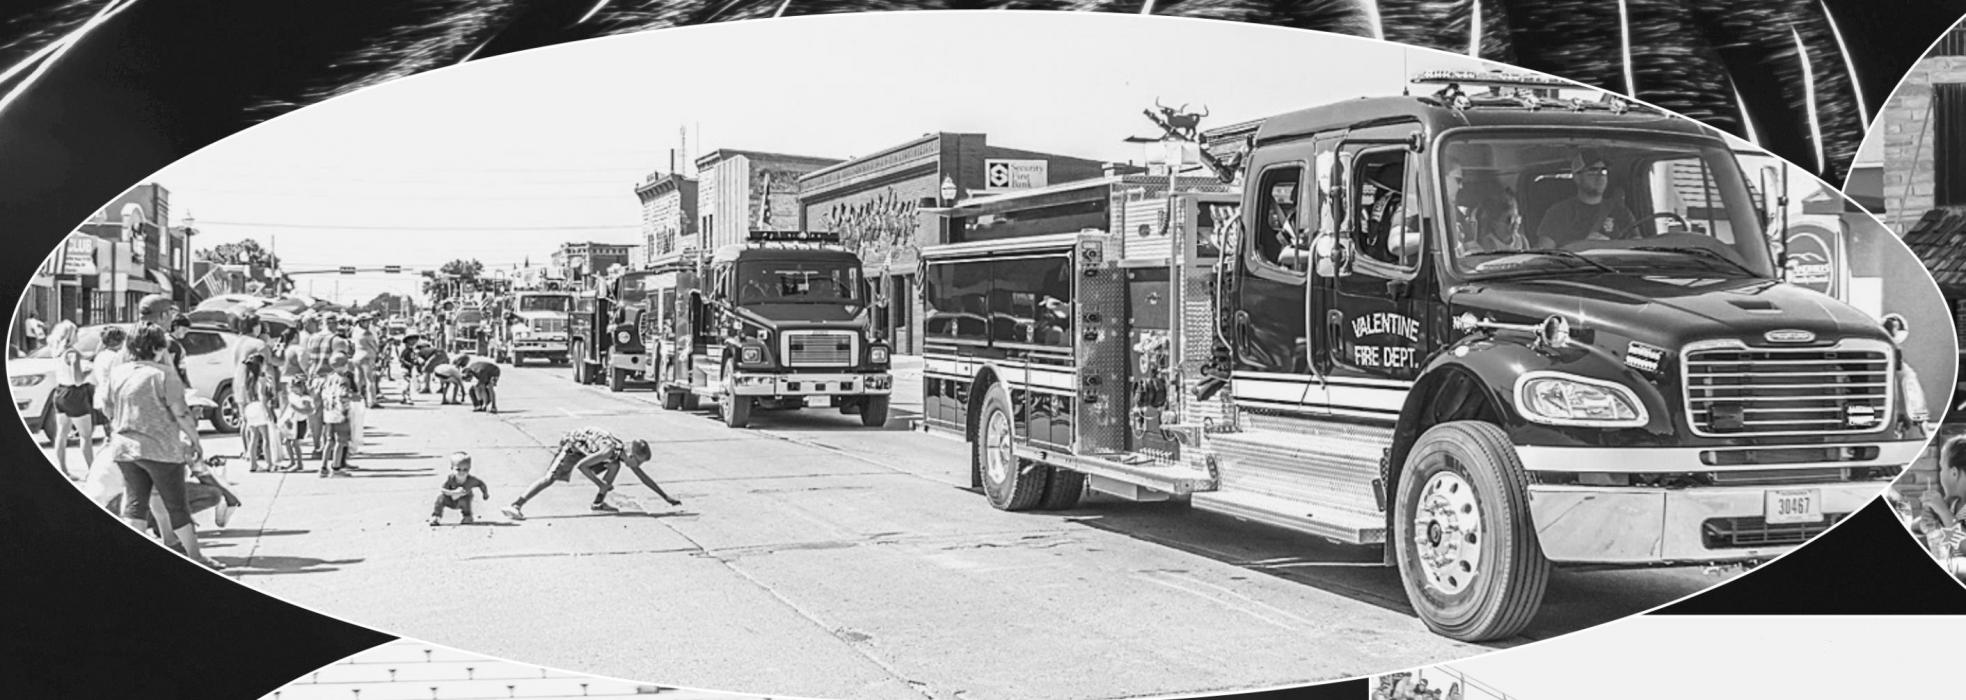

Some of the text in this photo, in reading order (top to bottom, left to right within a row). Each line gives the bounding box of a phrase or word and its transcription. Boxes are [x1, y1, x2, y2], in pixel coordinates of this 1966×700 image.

[1011, 164, 1043, 174] Security
[1012, 179, 1032, 188] Bank
[1351, 312, 1420, 342] VALENTINE
[1354, 345, 1420, 369] FIRE DEPT.
[1778, 496, 1811, 515] 30467
